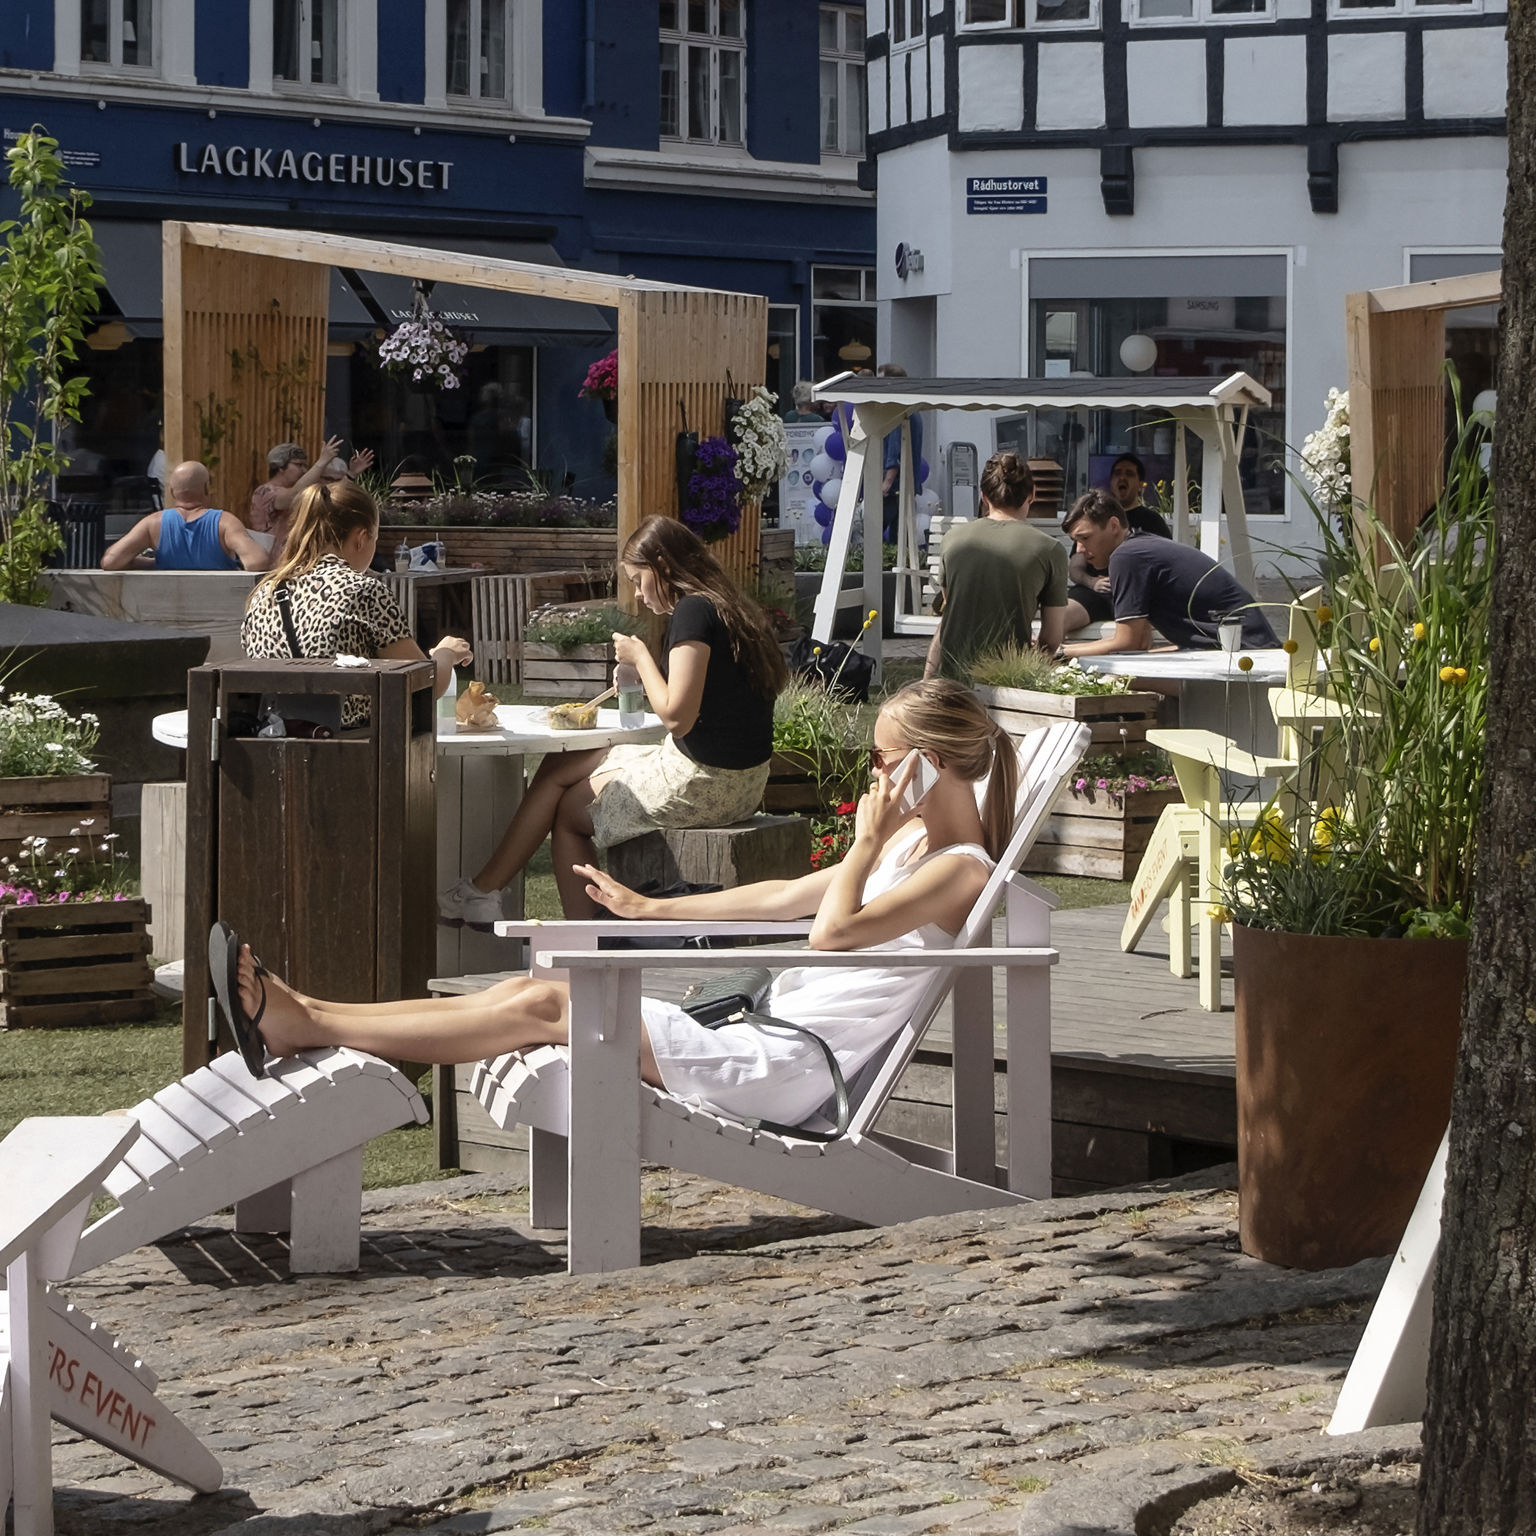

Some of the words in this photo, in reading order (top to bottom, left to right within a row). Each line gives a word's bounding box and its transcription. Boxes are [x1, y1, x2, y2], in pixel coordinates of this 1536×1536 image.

[180, 142, 454, 189] LAGKAGEHUSET
[972, 179, 1040, 191] Rådhustorvet
[80, 1371, 156, 1448] EVENT
